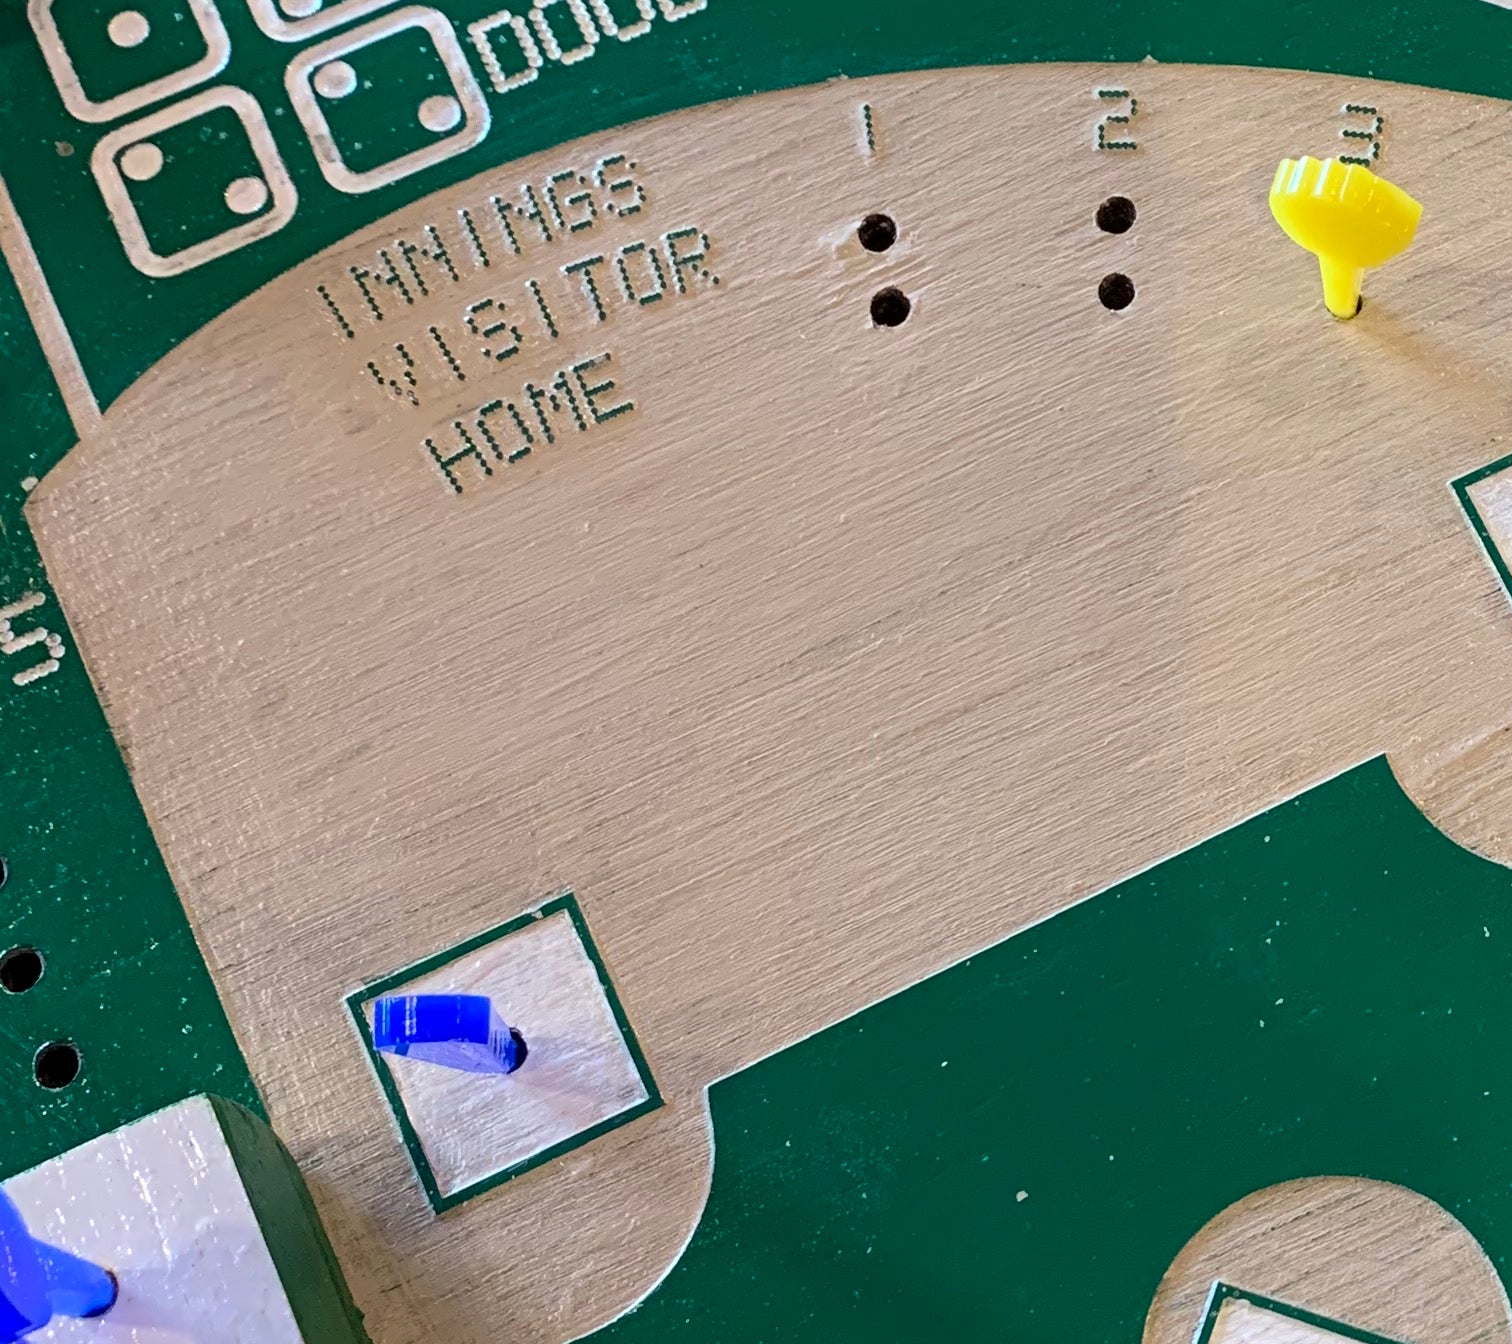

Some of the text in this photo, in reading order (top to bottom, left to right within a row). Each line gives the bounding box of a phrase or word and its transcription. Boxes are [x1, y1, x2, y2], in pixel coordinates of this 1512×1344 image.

[316, 154, 647, 339] INNINGS
[860, 103, 878, 153] 1
[1096, 88, 1138, 150] 2
[1339, 102, 1385, 167] 3
[366, 226, 721, 407] VISITOR
[424, 352, 636, 495] HOME
